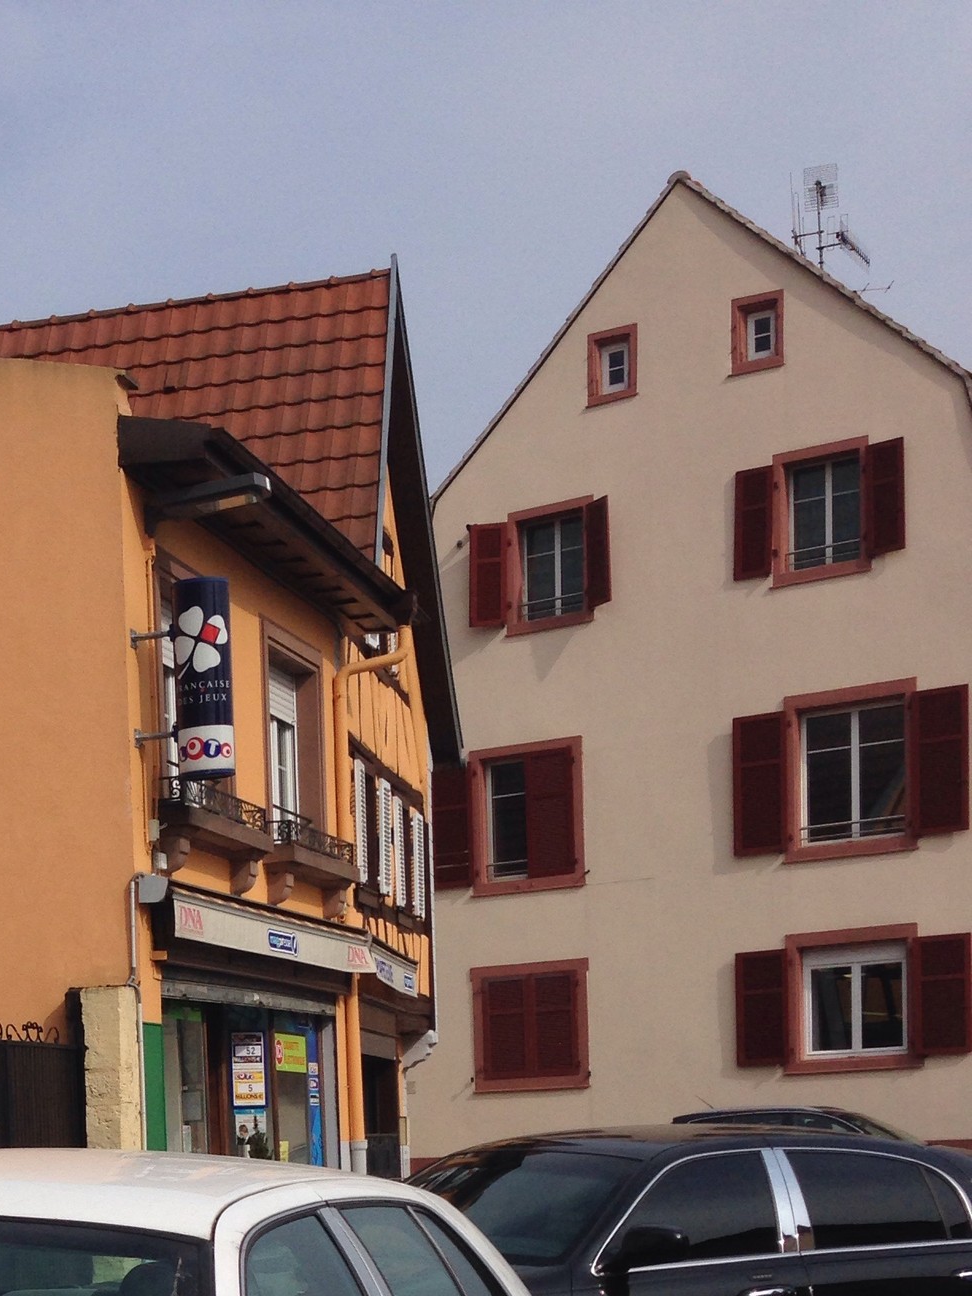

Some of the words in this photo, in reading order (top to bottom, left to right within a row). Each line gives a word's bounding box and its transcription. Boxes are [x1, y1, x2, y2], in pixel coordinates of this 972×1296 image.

[179, 679, 230, 692] RANÇAISE
[199, 693, 227, 704] JEUX
[180, 905, 203, 929] DNA
[348, 945, 369, 964] DNA
[246, 1046, 256, 1055] 52
[248, 1084, 253, 1092] 5
